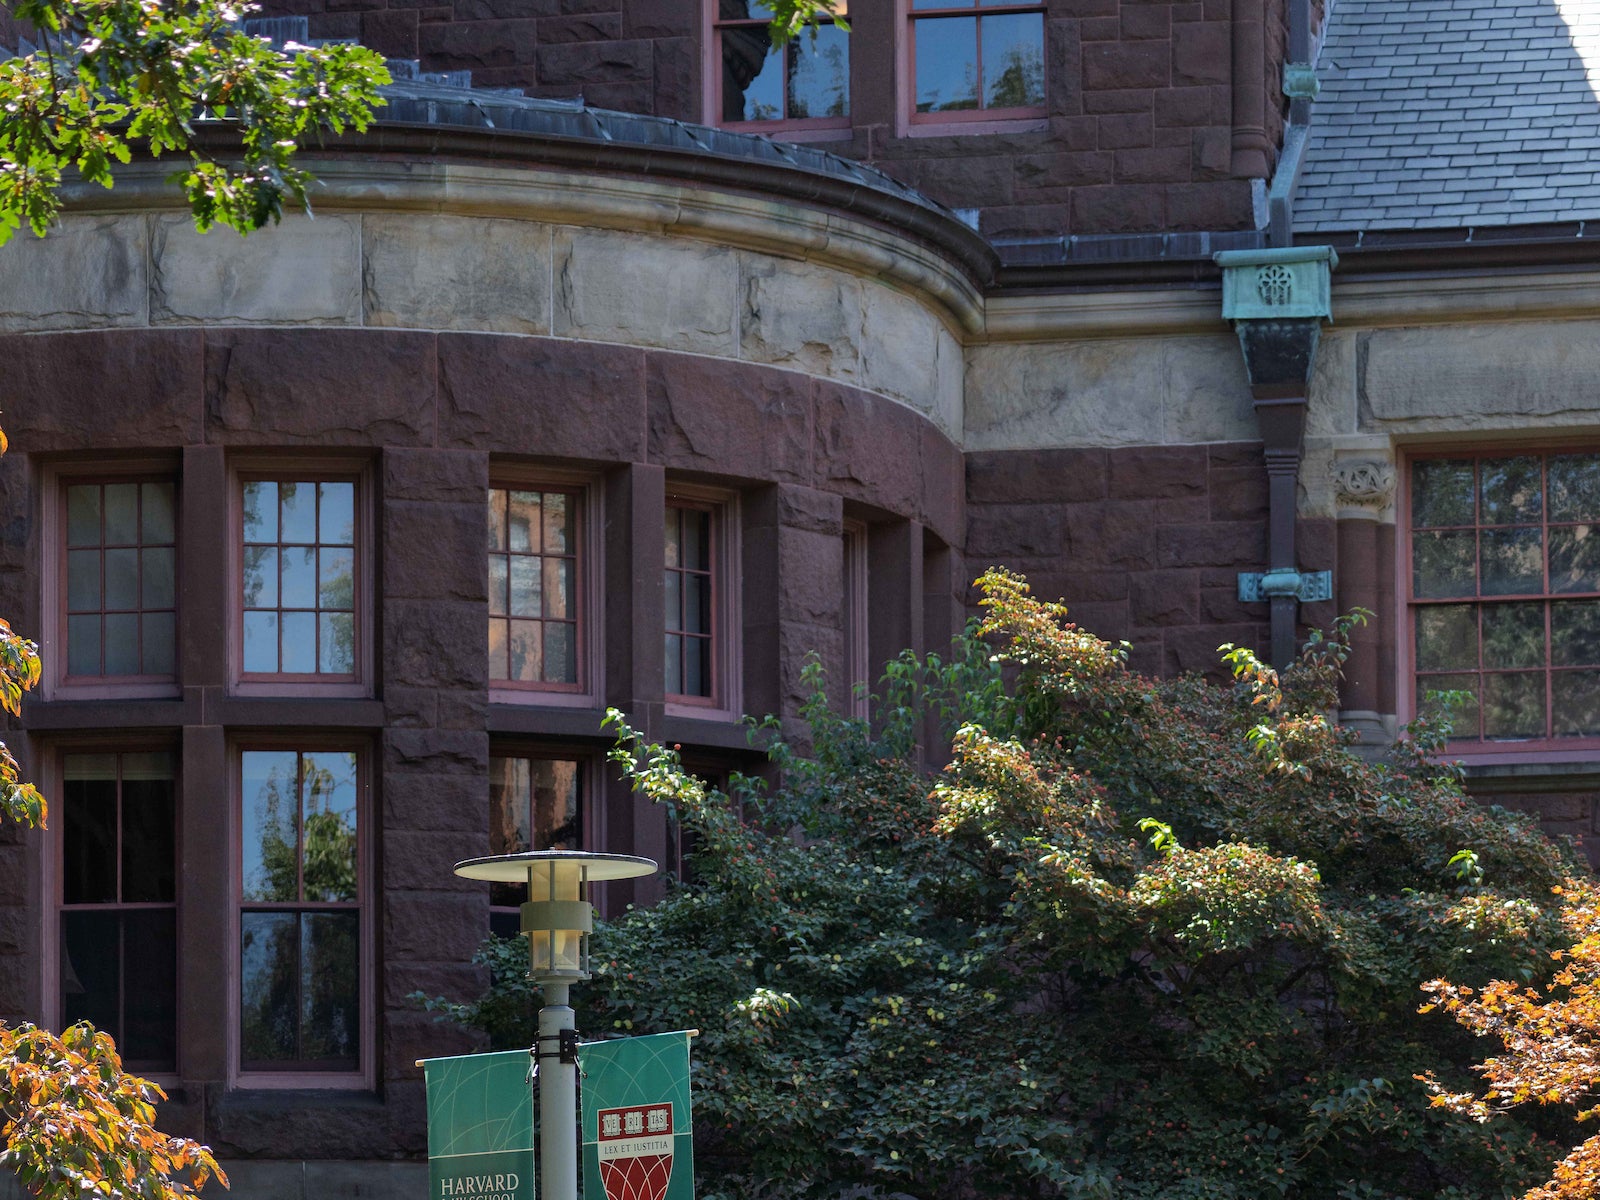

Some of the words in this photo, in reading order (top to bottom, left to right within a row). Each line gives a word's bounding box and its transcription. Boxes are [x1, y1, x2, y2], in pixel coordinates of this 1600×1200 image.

[652, 1114, 664, 1124] TAS
[604, 1145, 618, 1155] LEX
[621, 1144, 631, 1153] ET
[634, 1141, 668, 1152] IUSTITIA
[441, 1173, 519, 1196] HARVARD
